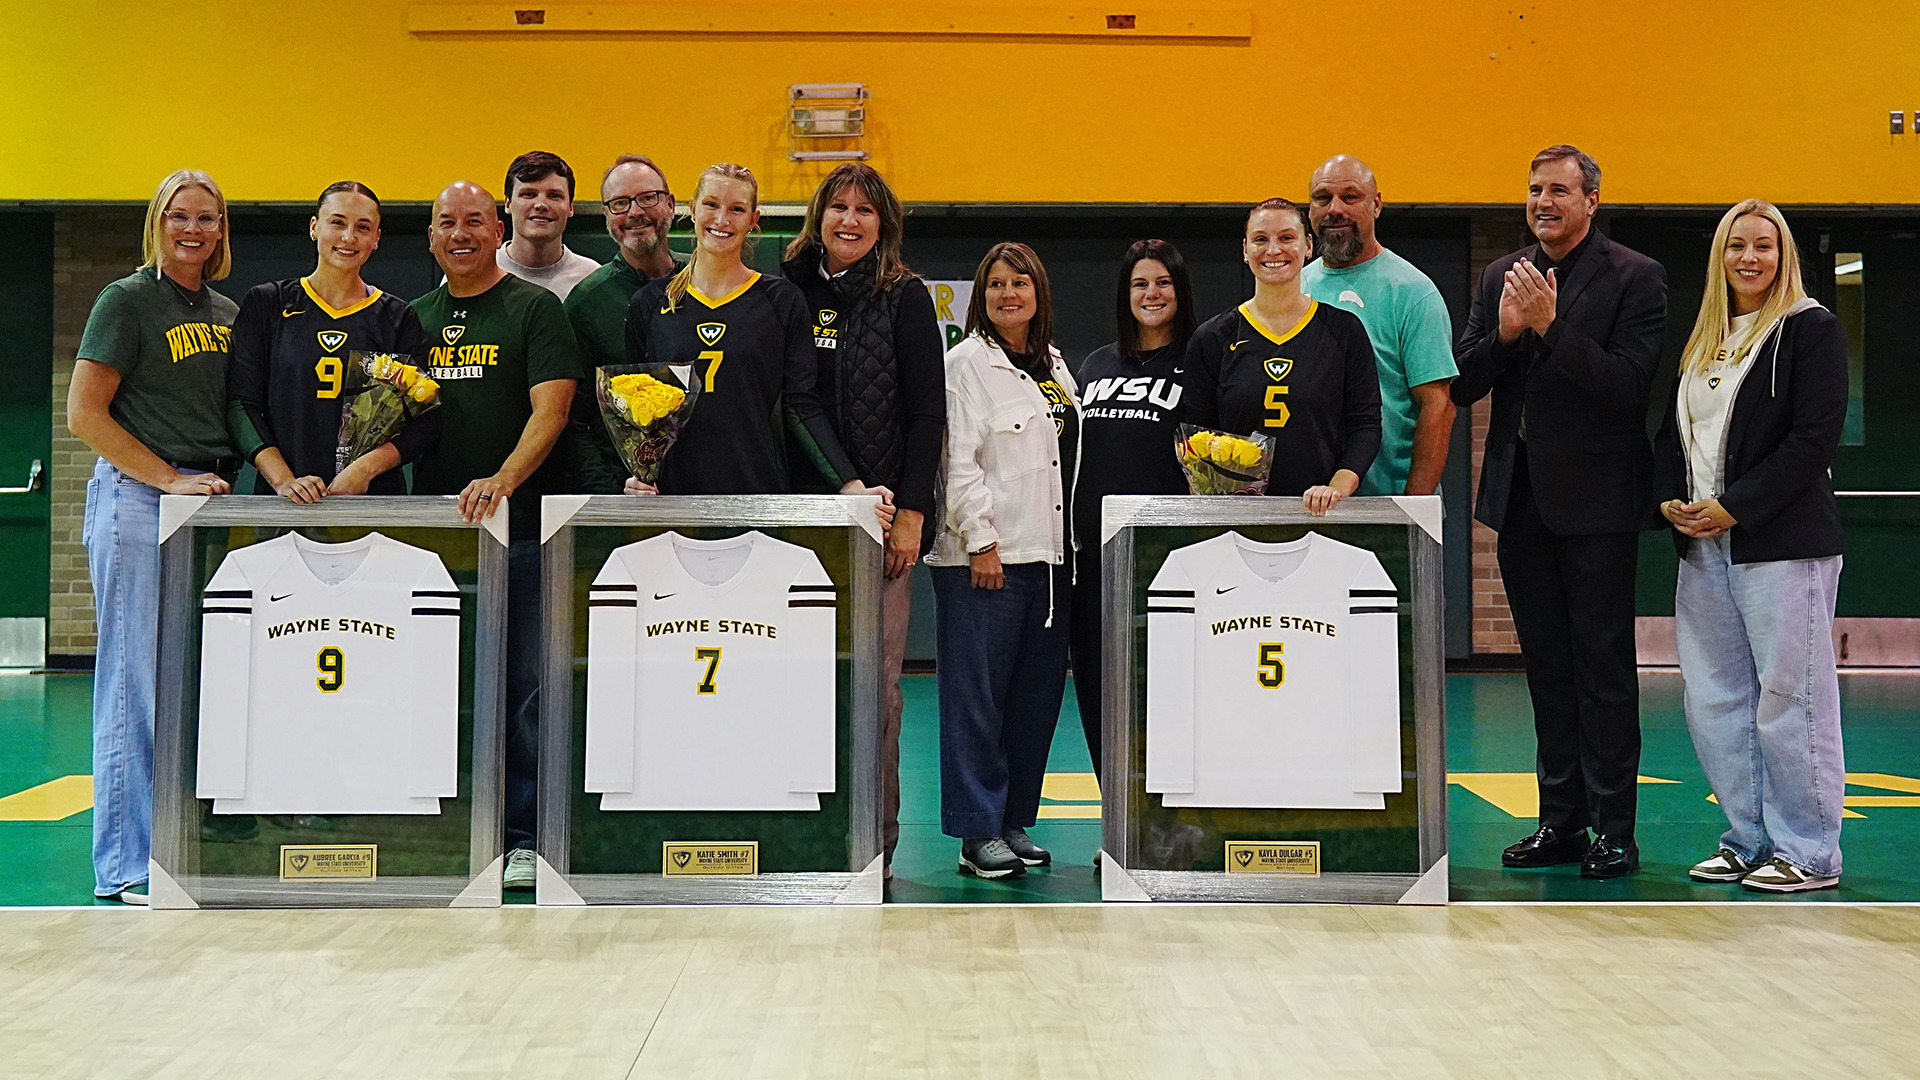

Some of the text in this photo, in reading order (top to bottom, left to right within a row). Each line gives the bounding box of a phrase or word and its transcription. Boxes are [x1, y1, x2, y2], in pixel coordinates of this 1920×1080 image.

[165, 322, 218, 363] WAYNE
[457, 344, 499, 367] STATE
[315, 356, 343, 398] 9
[698, 351, 724, 393] 7
[1082, 376, 1183, 411] WSU
[1264, 385, 1291, 428] 5
[1082, 407, 1161, 422] VOLLEYBALL
[267, 618, 397, 640] WAYNE STATE
[646, 619, 778, 640] WAYNE STATE
[1211, 615, 1337, 638] WAYNE STATE
[317, 645, 345, 694] 9
[695, 646, 723, 695] 7
[1257, 642, 1286, 690] 5
[697, 850, 716, 858] KATIE
[717, 850, 738, 858] SMITH
[1258, 849, 1278, 858] KAYLA
[1279, 849, 1303, 858] DULGAR
